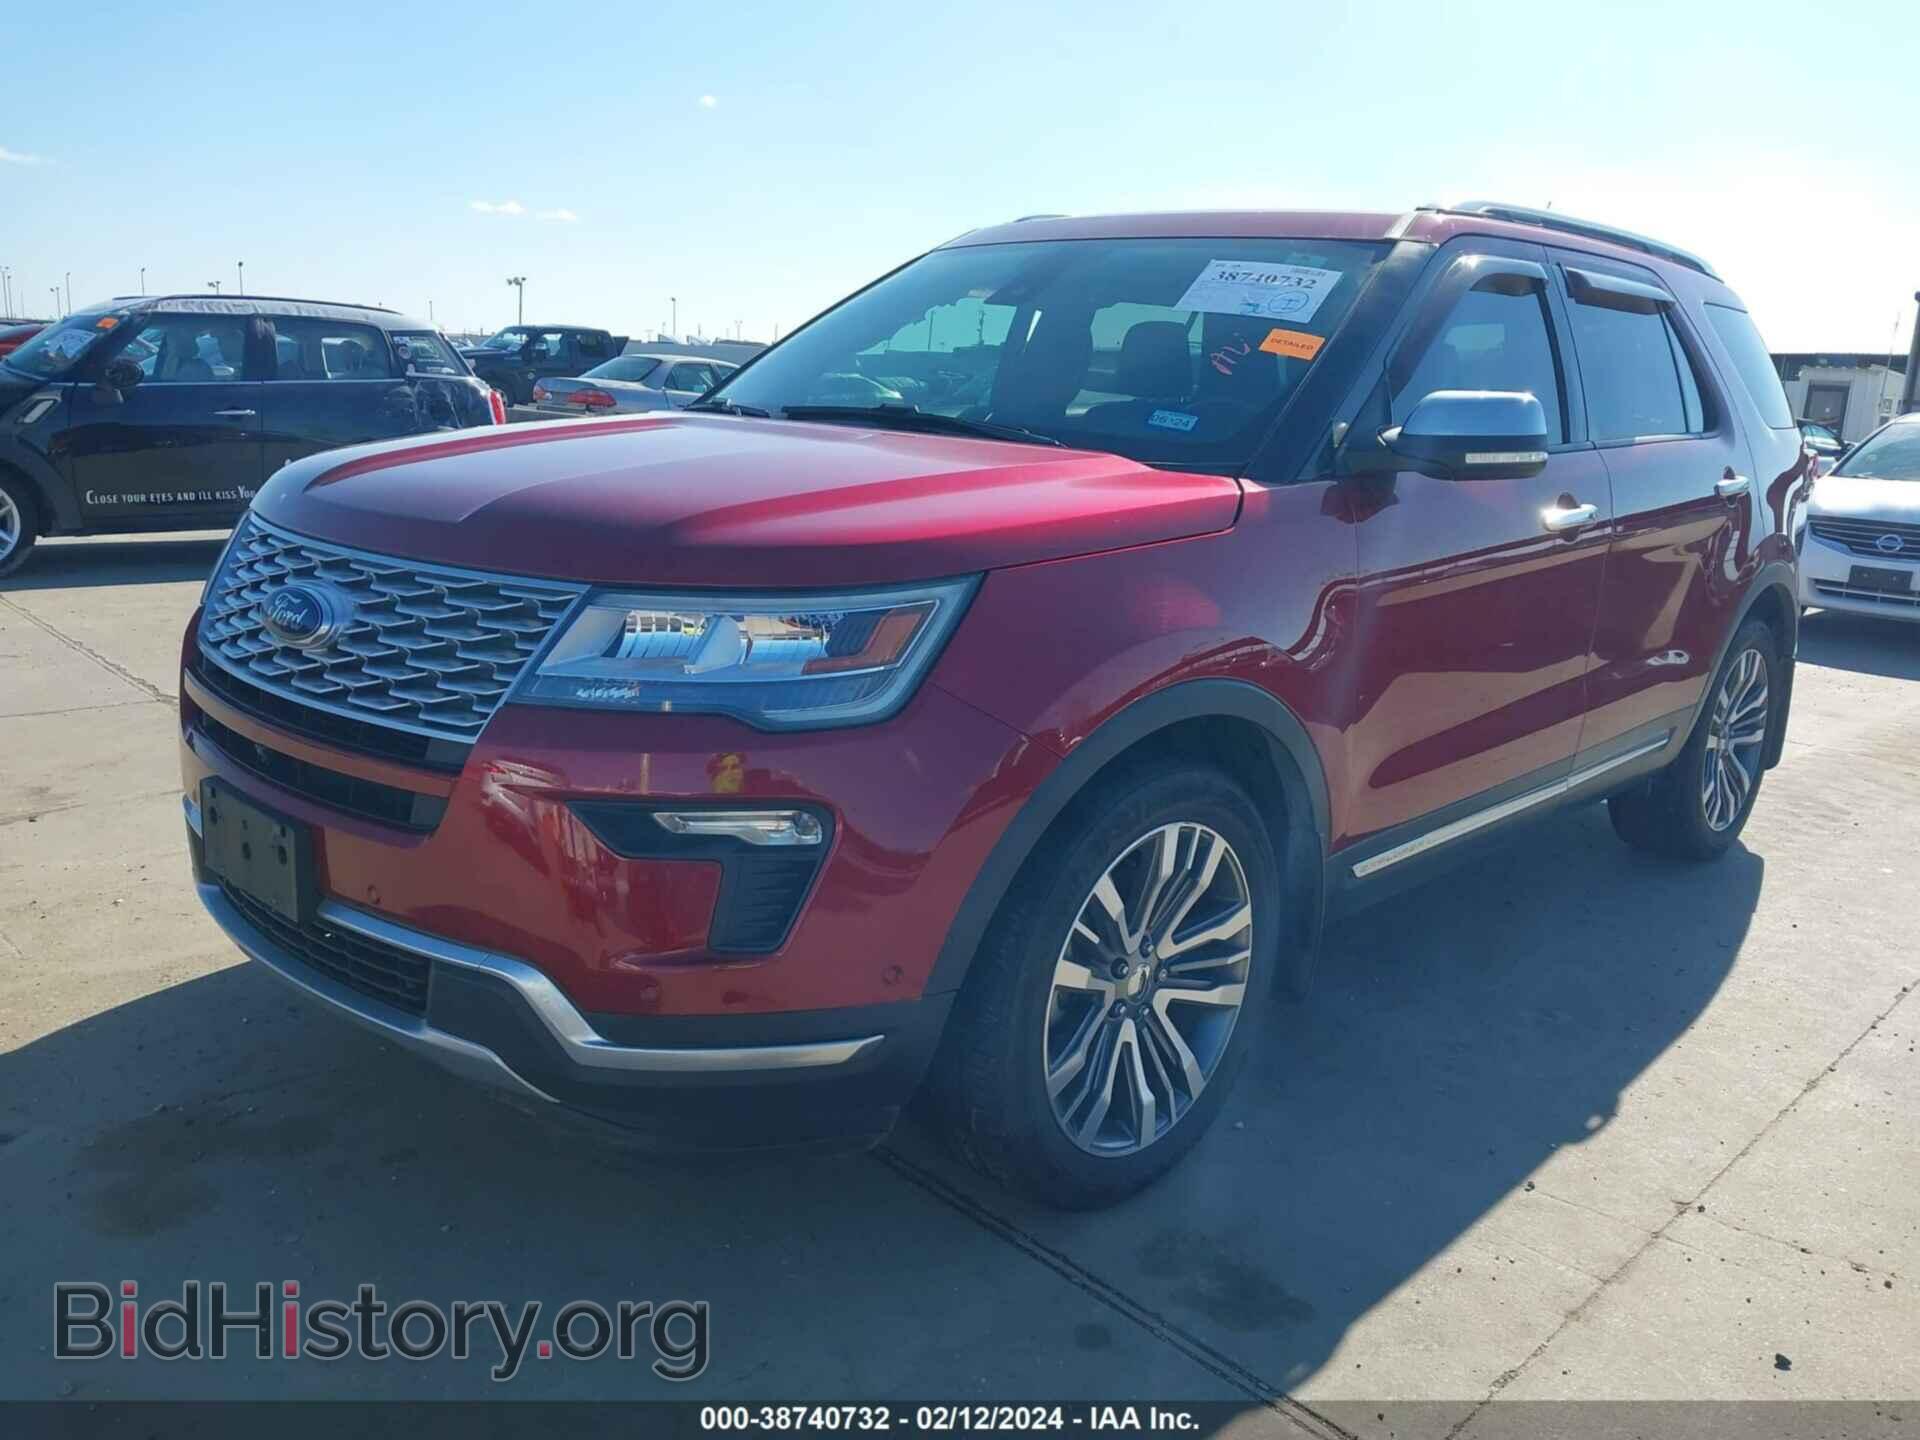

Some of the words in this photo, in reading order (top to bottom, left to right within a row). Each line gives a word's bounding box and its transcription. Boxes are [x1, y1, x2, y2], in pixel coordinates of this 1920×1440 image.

[1211, 270, 1317, 290] 38740732
[1269, 337, 1314, 351] DETAILED
[122, 493, 147, 504] YOUR
[150, 491, 174, 504] EYES
[177, 491, 196, 502] AND
[215, 489, 237, 500] KISS
[271, 592, 309, 625] Ford
